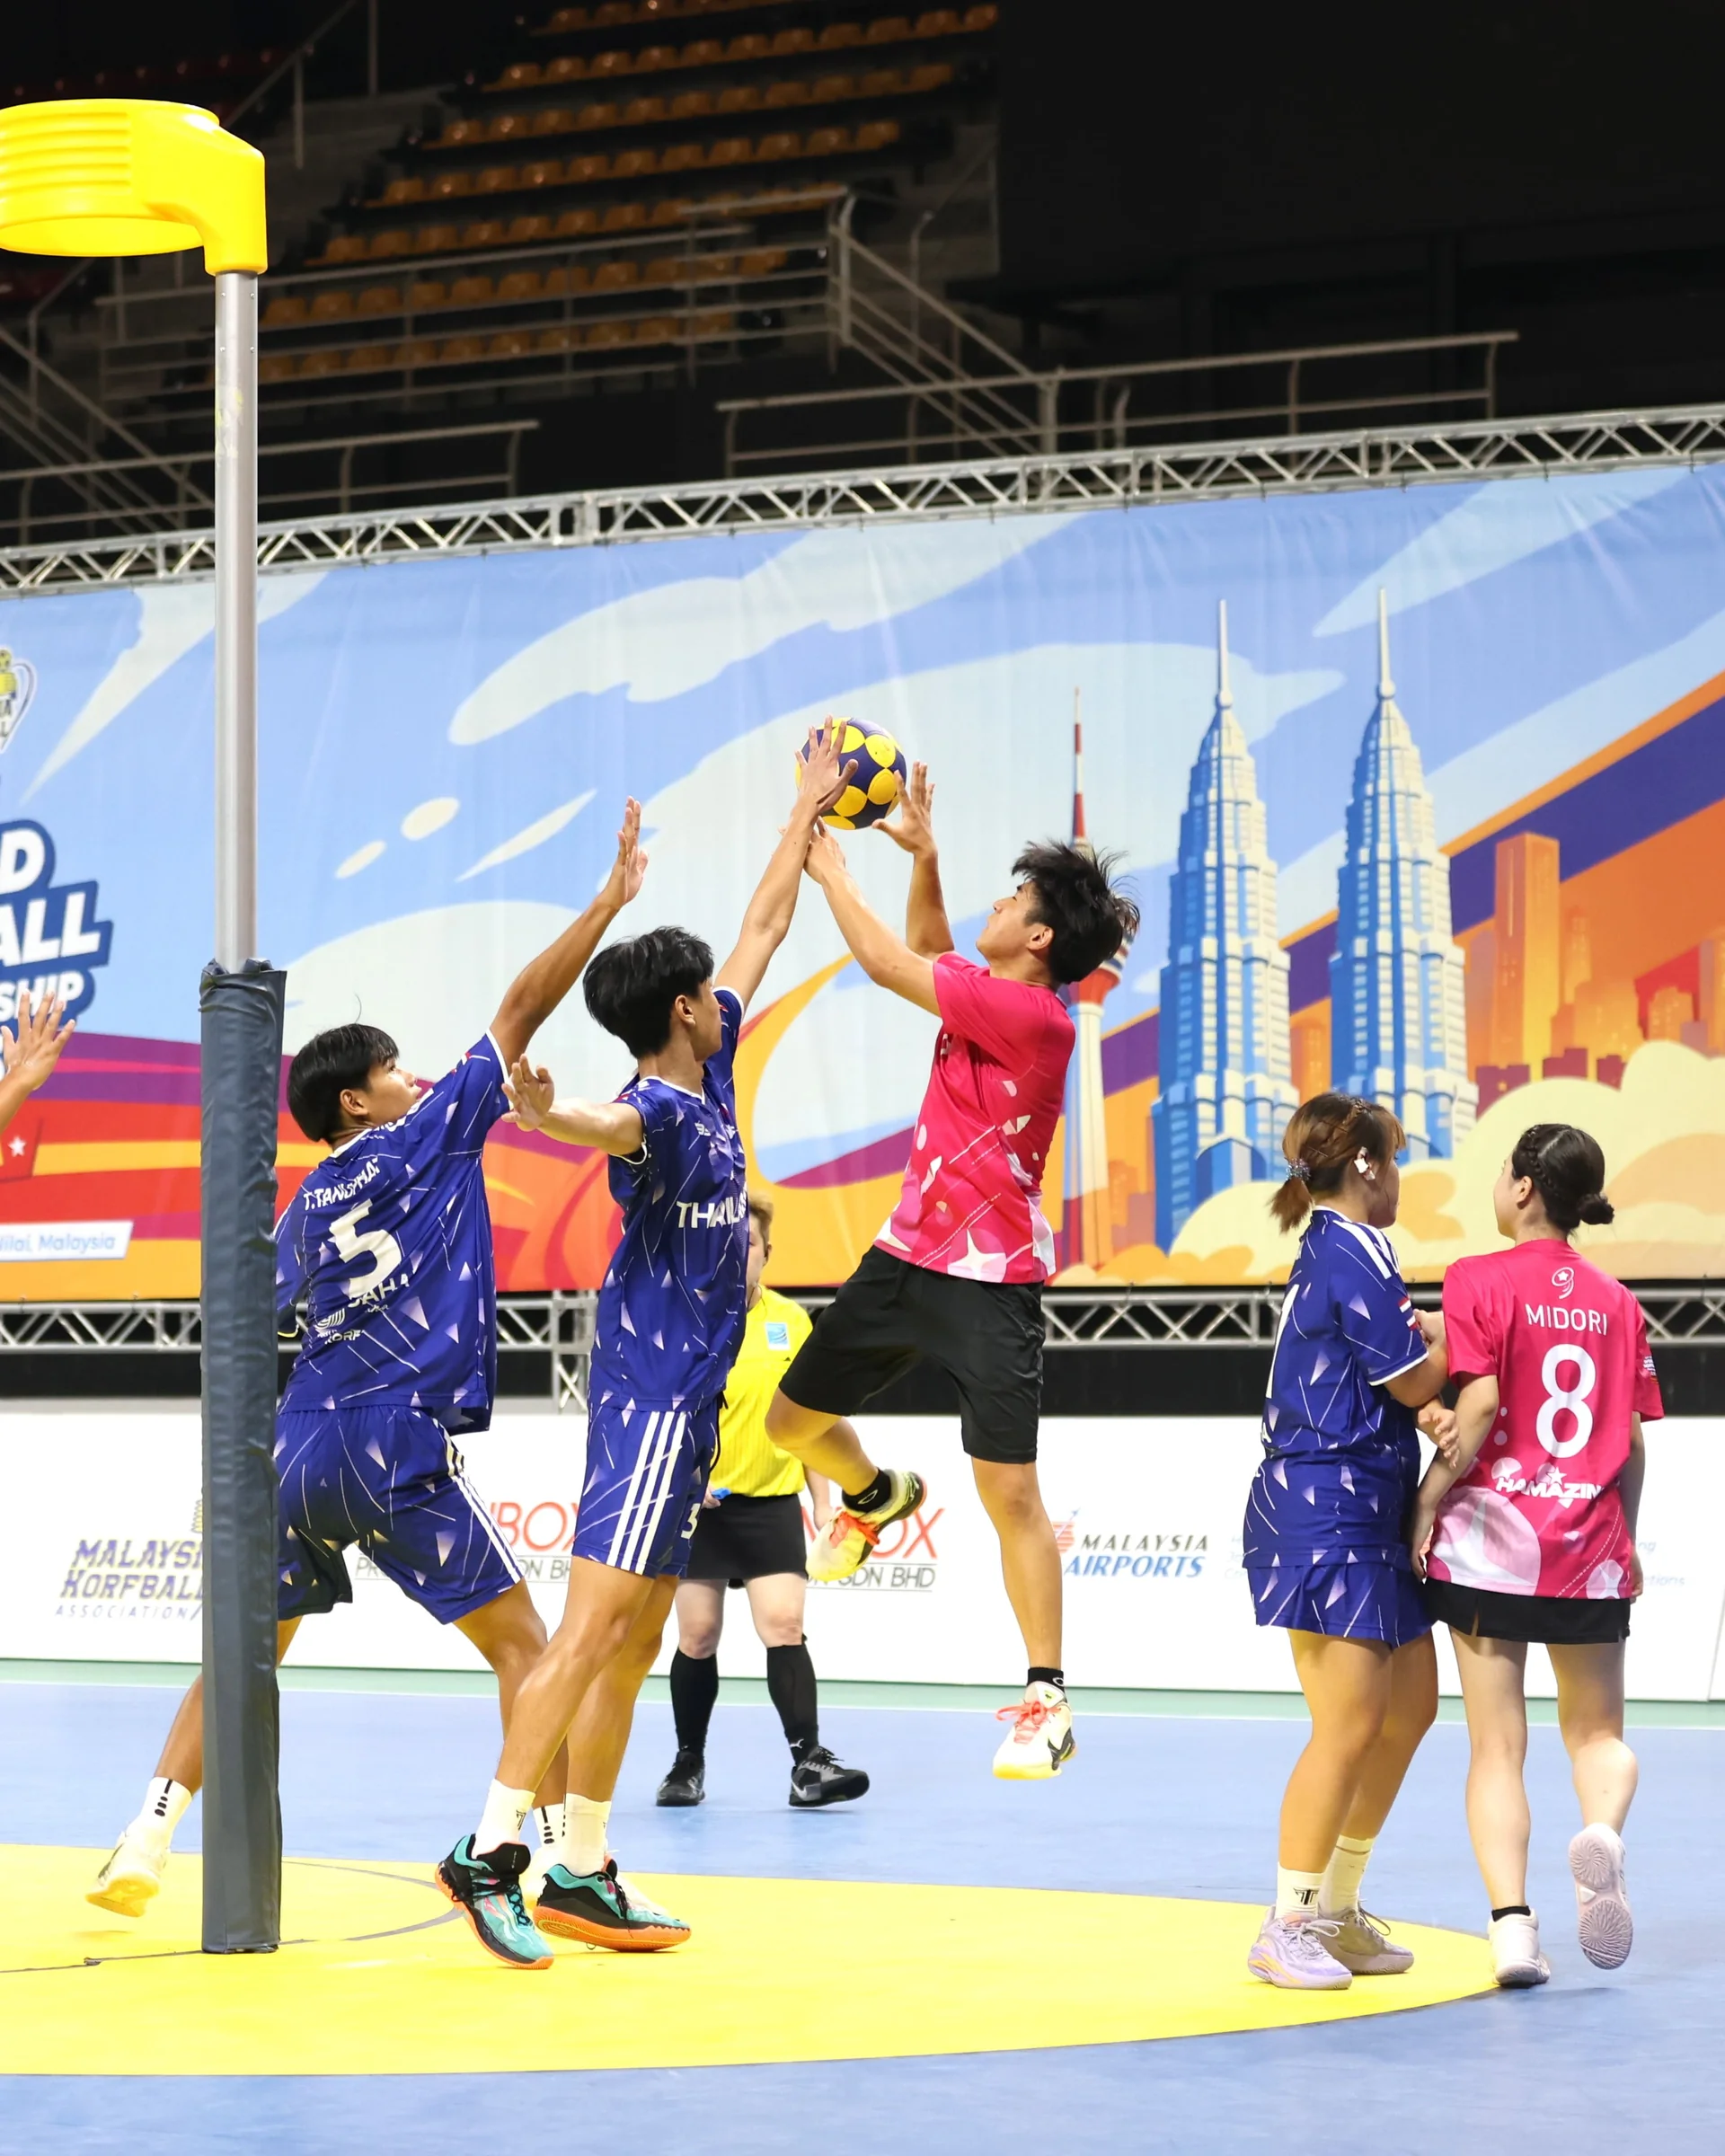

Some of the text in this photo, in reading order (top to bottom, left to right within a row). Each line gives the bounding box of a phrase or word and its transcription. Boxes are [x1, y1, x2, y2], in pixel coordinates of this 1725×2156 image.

[39, 1232, 116, 1255] Malaysia
[329, 1197, 402, 1301] 5
[1526, 1303, 1608, 1336] MIDORI
[1535, 1343, 1597, 1459] 8
[1495, 1476, 1605, 1500] HAMAZIN
[680, 1503, 701, 1539] 3
[71, 1539, 202, 1568] MALAYSI
[1081, 1534, 1209, 1551] MALAYSIA
[890, 1567, 936, 1589] BHD
[1064, 1555, 1207, 1578] AIRPORTS
[55, 1604, 189, 1620] ASSOCIATION
